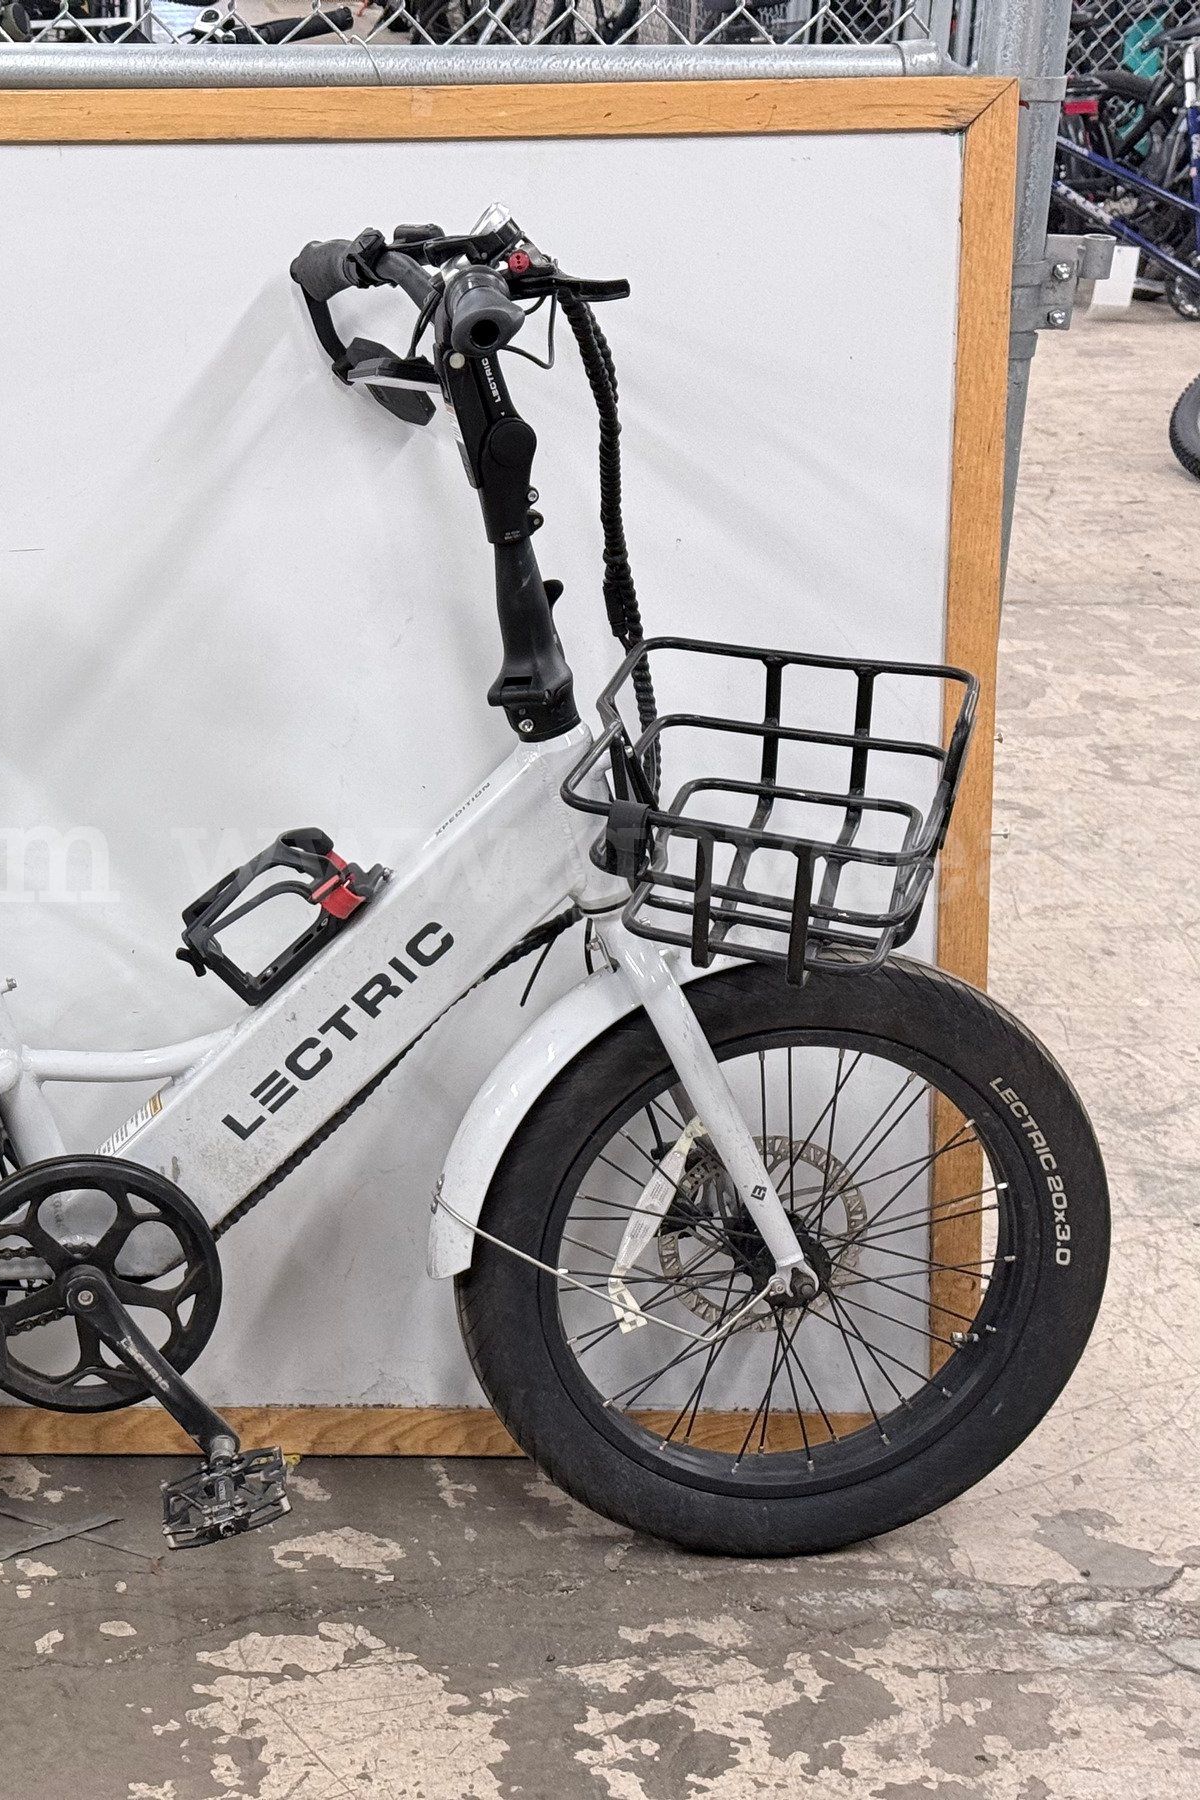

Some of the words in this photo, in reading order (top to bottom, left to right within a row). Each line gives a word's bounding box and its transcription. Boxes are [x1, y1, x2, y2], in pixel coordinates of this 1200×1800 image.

[481, 357, 501, 403] LECTRIC
[435, 782, 491, 837] XPEDITION
[221, 922, 455, 1141] LECTRIC
[989, 1076, 1058, 1172] LECTRIC
[1046, 1174, 1071, 1266] 20x3.0
